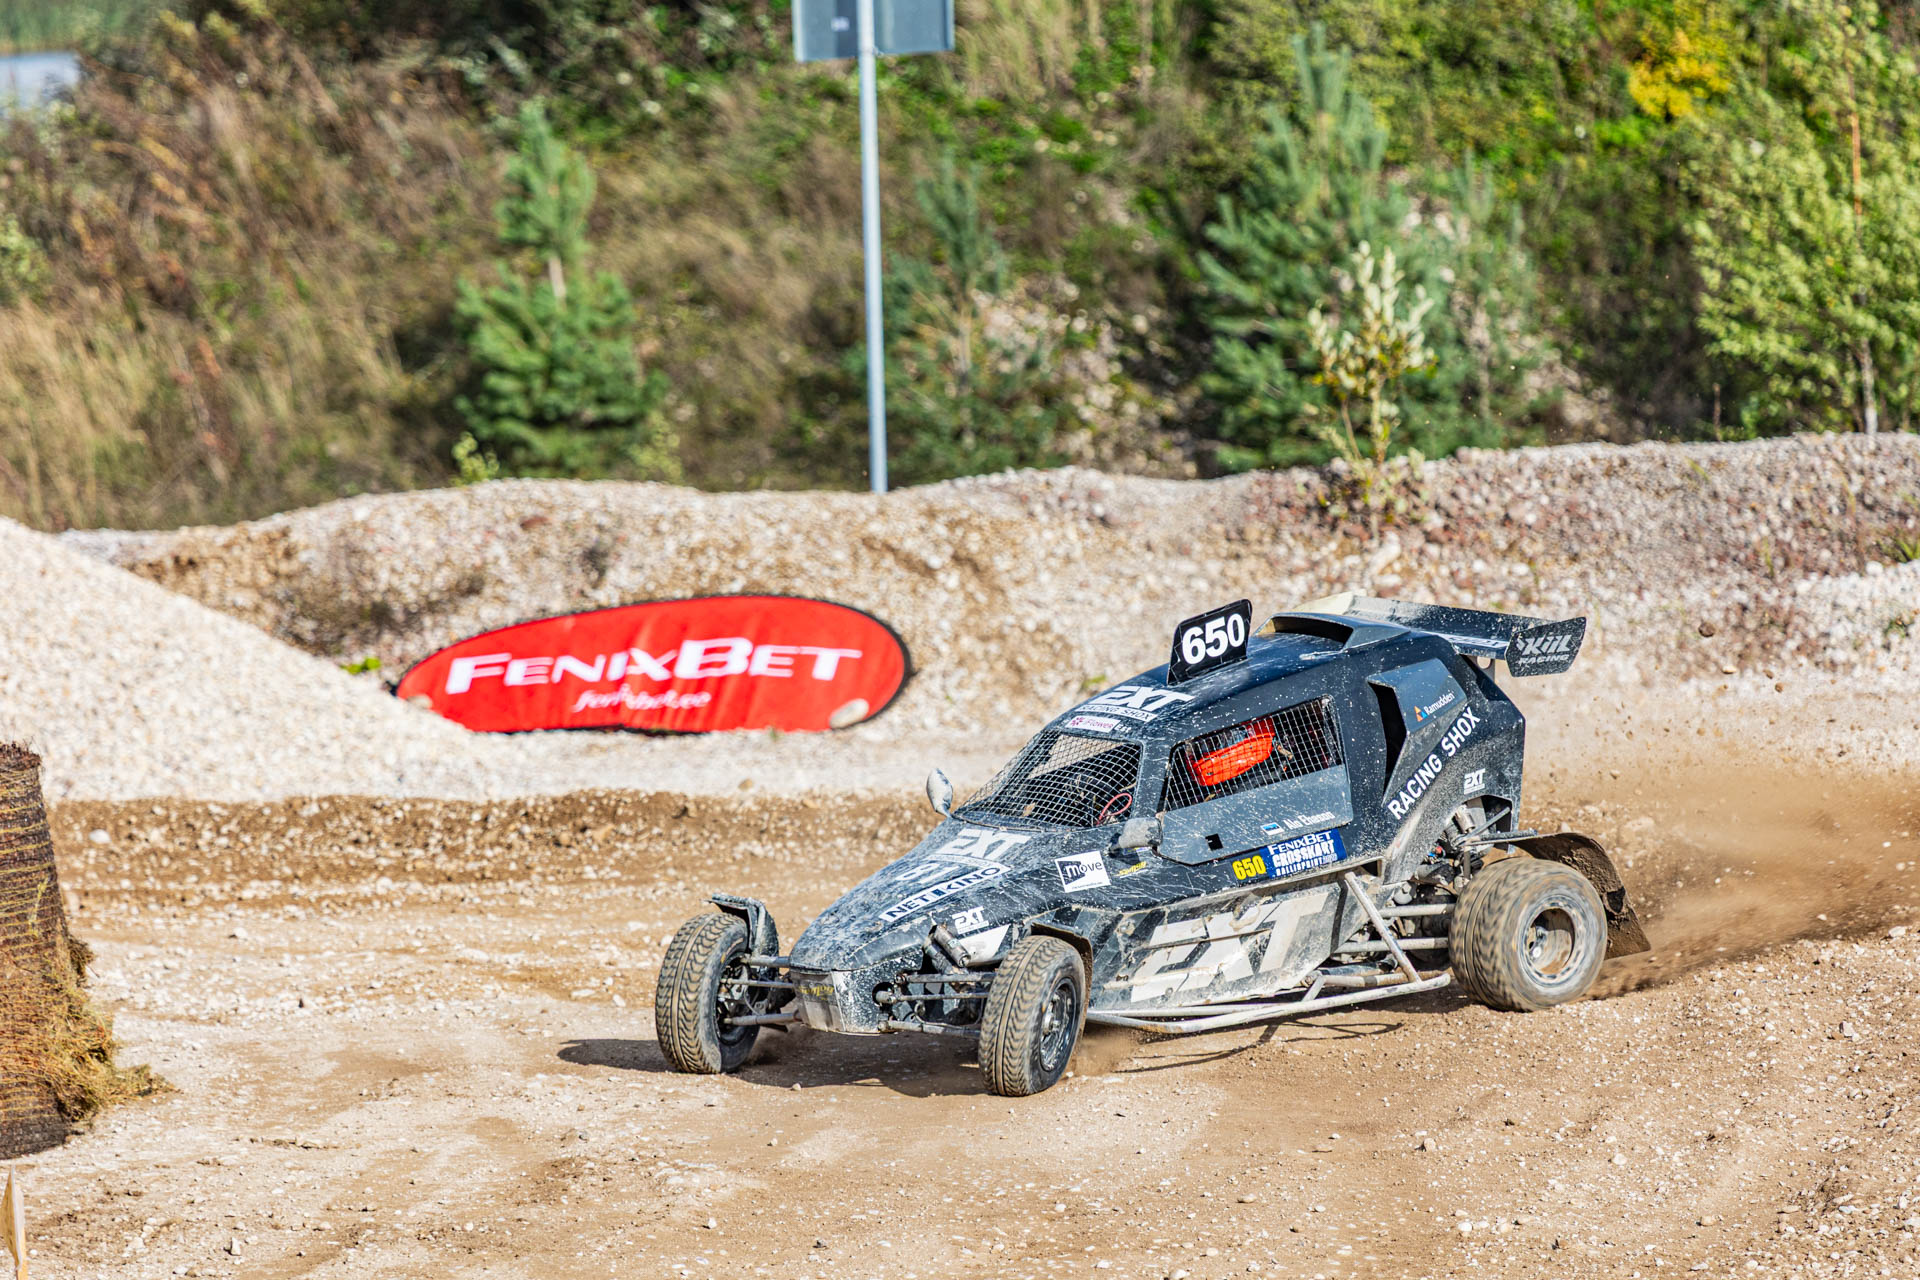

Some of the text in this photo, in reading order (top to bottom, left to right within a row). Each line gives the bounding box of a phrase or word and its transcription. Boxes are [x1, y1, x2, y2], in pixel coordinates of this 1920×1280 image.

[1182, 613, 1246, 665] 650
[445, 637, 863, 694] FENIXBET
[1519, 654, 1571, 665] RACING
[1087, 685, 1196, 713] EXT
[1423, 692, 1456, 716] Ramudden
[1387, 754, 1443, 820] RACING
[1441, 706, 1481, 757] SHOX
[932, 827, 1032, 861] EXT
[1267, 831, 1332, 856] FENIXBET
[1272, 839, 1335, 868] CROSSKART
[1065, 861, 1104, 878] move
[1232, 855, 1267, 880] 650
